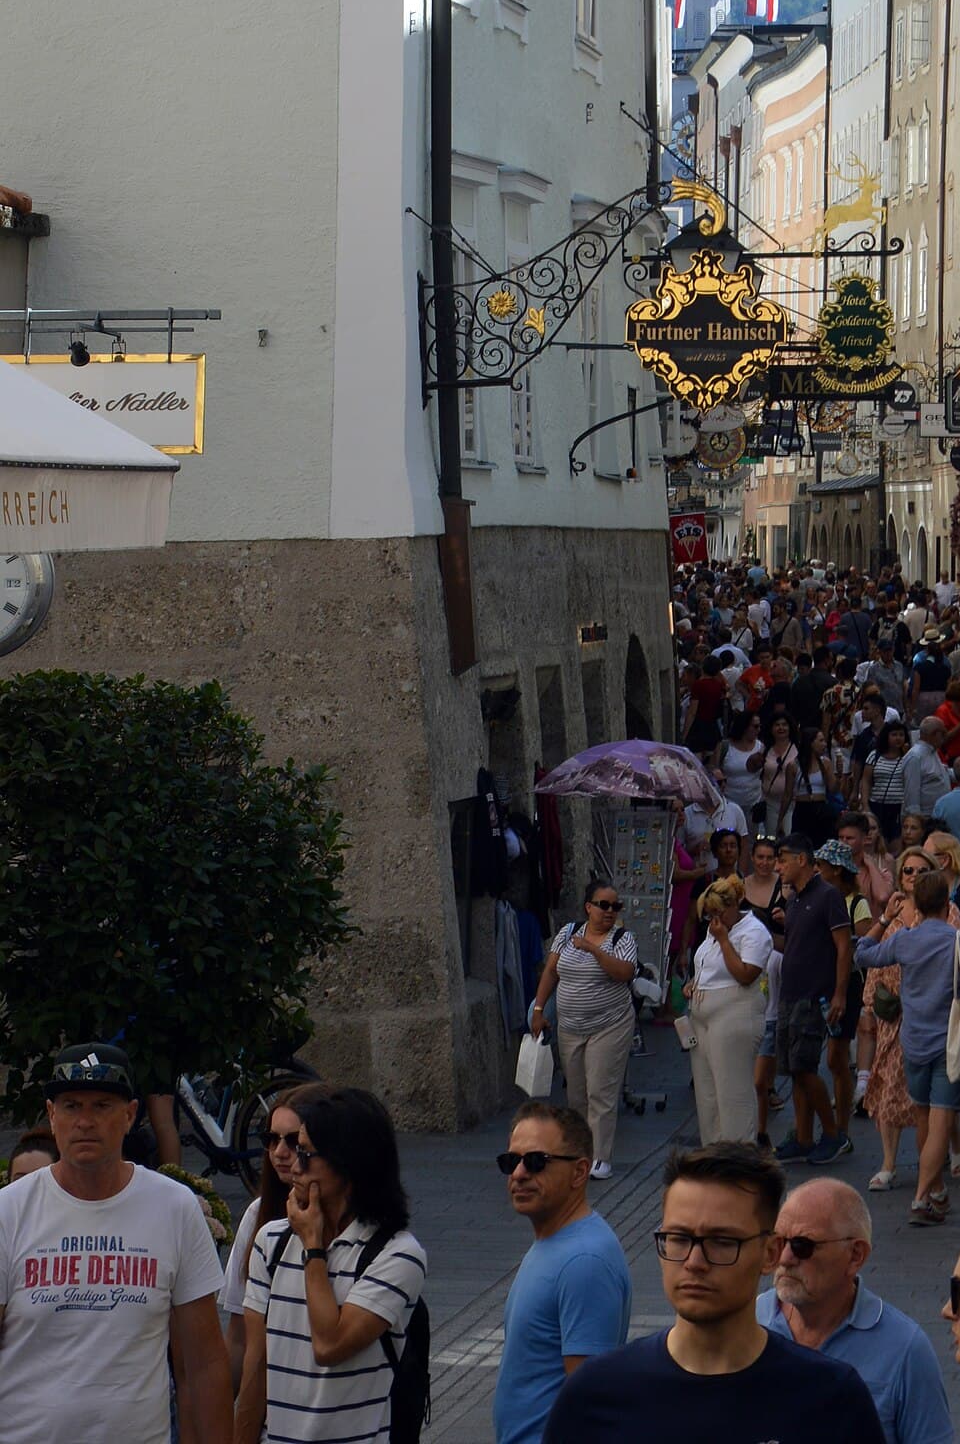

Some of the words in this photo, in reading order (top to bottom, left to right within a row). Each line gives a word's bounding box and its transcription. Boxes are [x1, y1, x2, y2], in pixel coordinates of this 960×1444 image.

[840, 294, 869, 308] Hotel
[835, 316, 878, 327] Goldener
[634, 321, 702, 342] Furtner
[707, 321, 777, 342] Hanisch
[840, 334, 874, 347] Hirsch
[61, 1235, 126, 1253] ORIGINAL
[24, 1255, 82, 1288] BLUE
[87, 1254, 158, 1289] DENIM
[31, 1288, 60, 1305] True
[63, 1287, 107, 1308] Indigo
[110, 1287, 149, 1306] Goods
